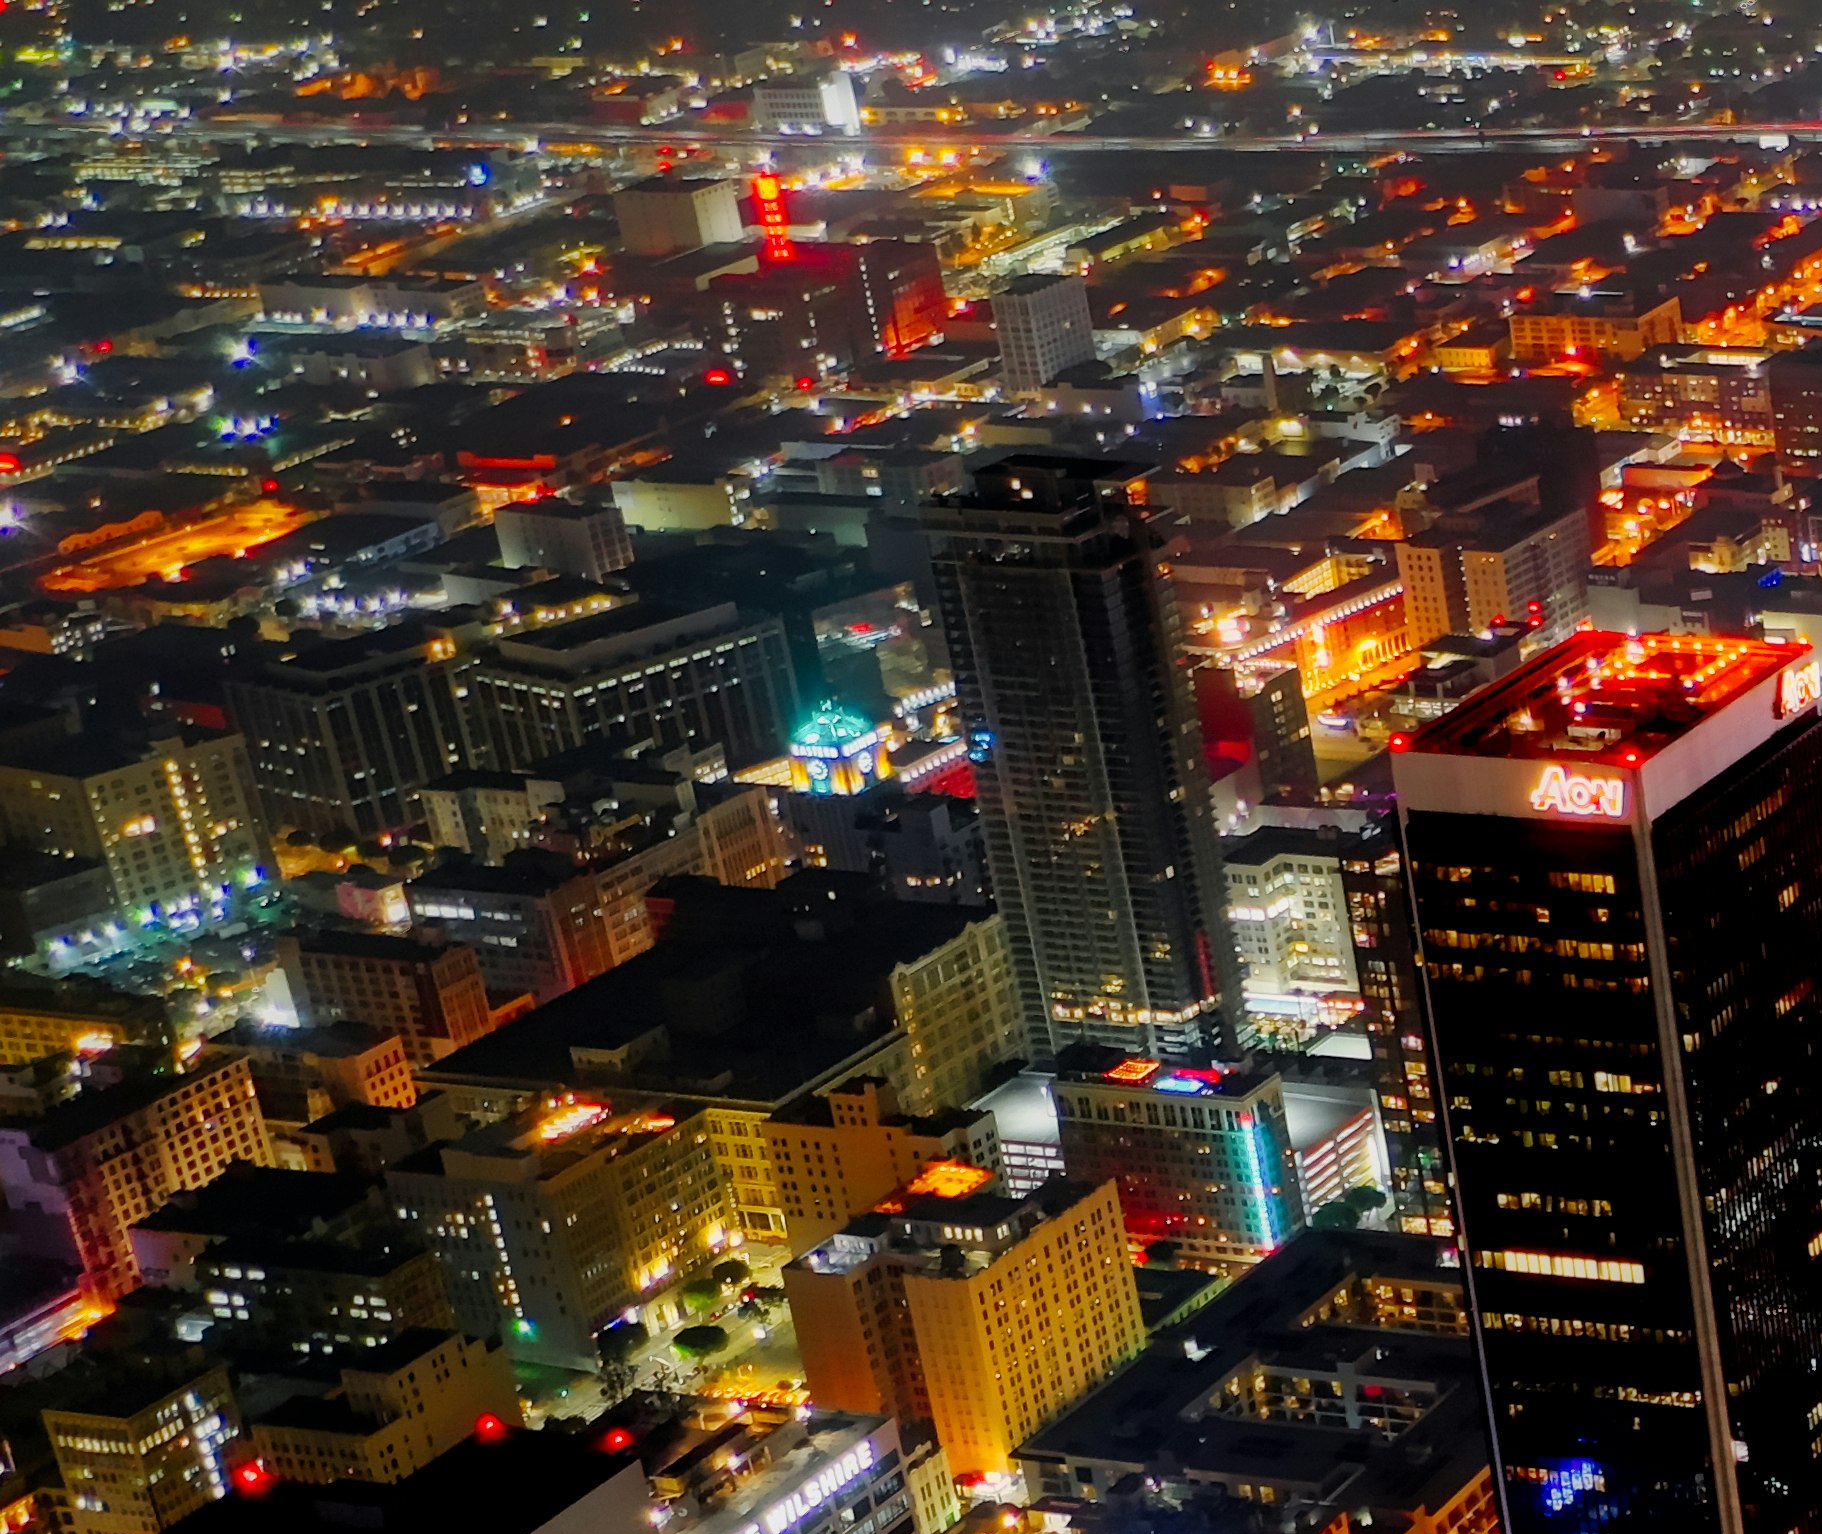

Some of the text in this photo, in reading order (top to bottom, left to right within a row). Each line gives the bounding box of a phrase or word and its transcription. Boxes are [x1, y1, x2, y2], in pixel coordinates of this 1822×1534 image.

[1780, 660, 1820, 716] AON
[1532, 765, 1625, 819] AON
[764, 1440, 876, 1534] WILSHIRE
